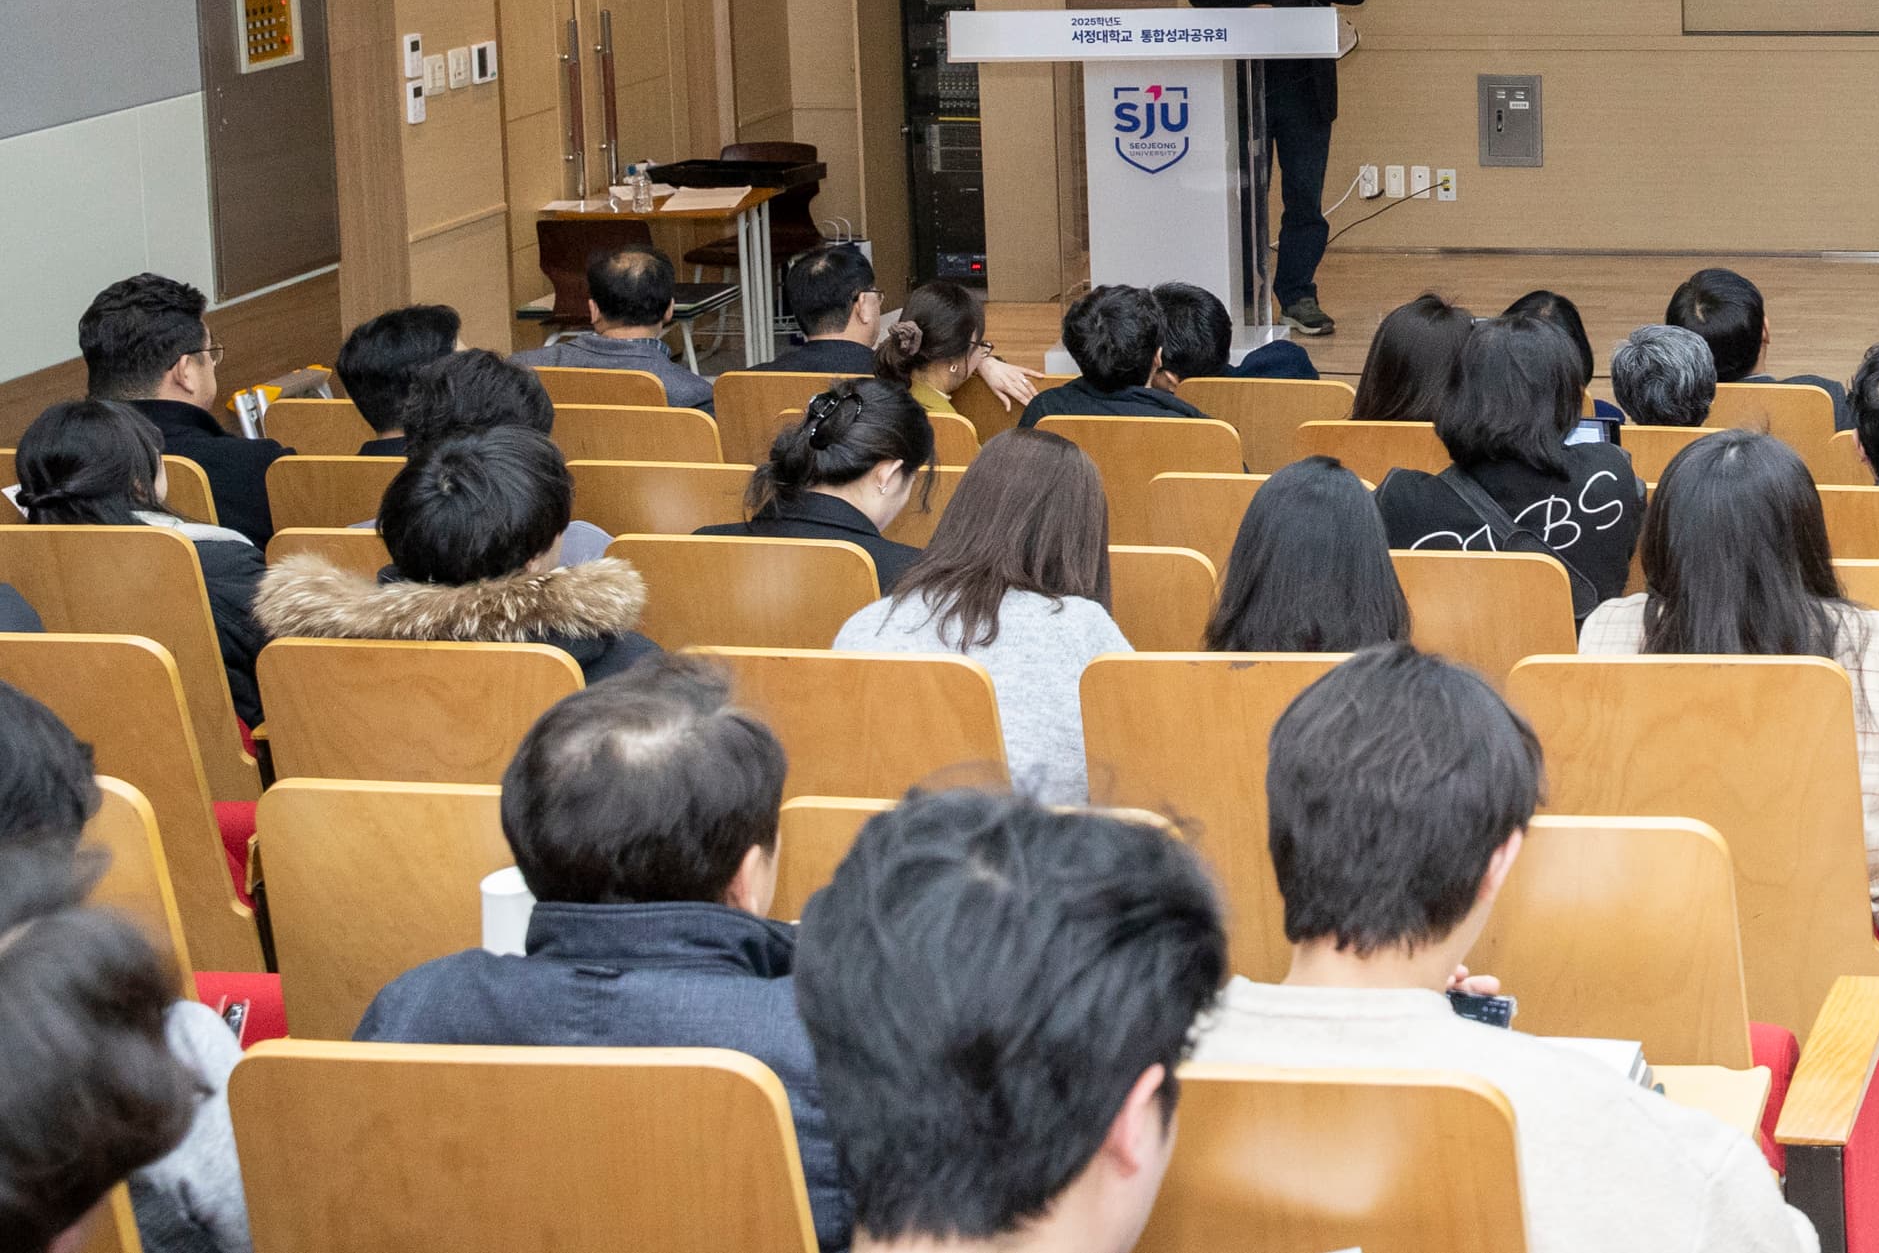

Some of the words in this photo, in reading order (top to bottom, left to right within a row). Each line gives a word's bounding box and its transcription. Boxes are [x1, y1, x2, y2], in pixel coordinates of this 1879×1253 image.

[1071, 17, 1122, 27] 2025학년도
[1072, 29, 1133, 44] 서정대학교
[1140, 28, 1228, 44] 통합성과공유회
[1114, 85, 1189, 139] SJU
[1129, 142, 1177, 150] SEOJEONG
